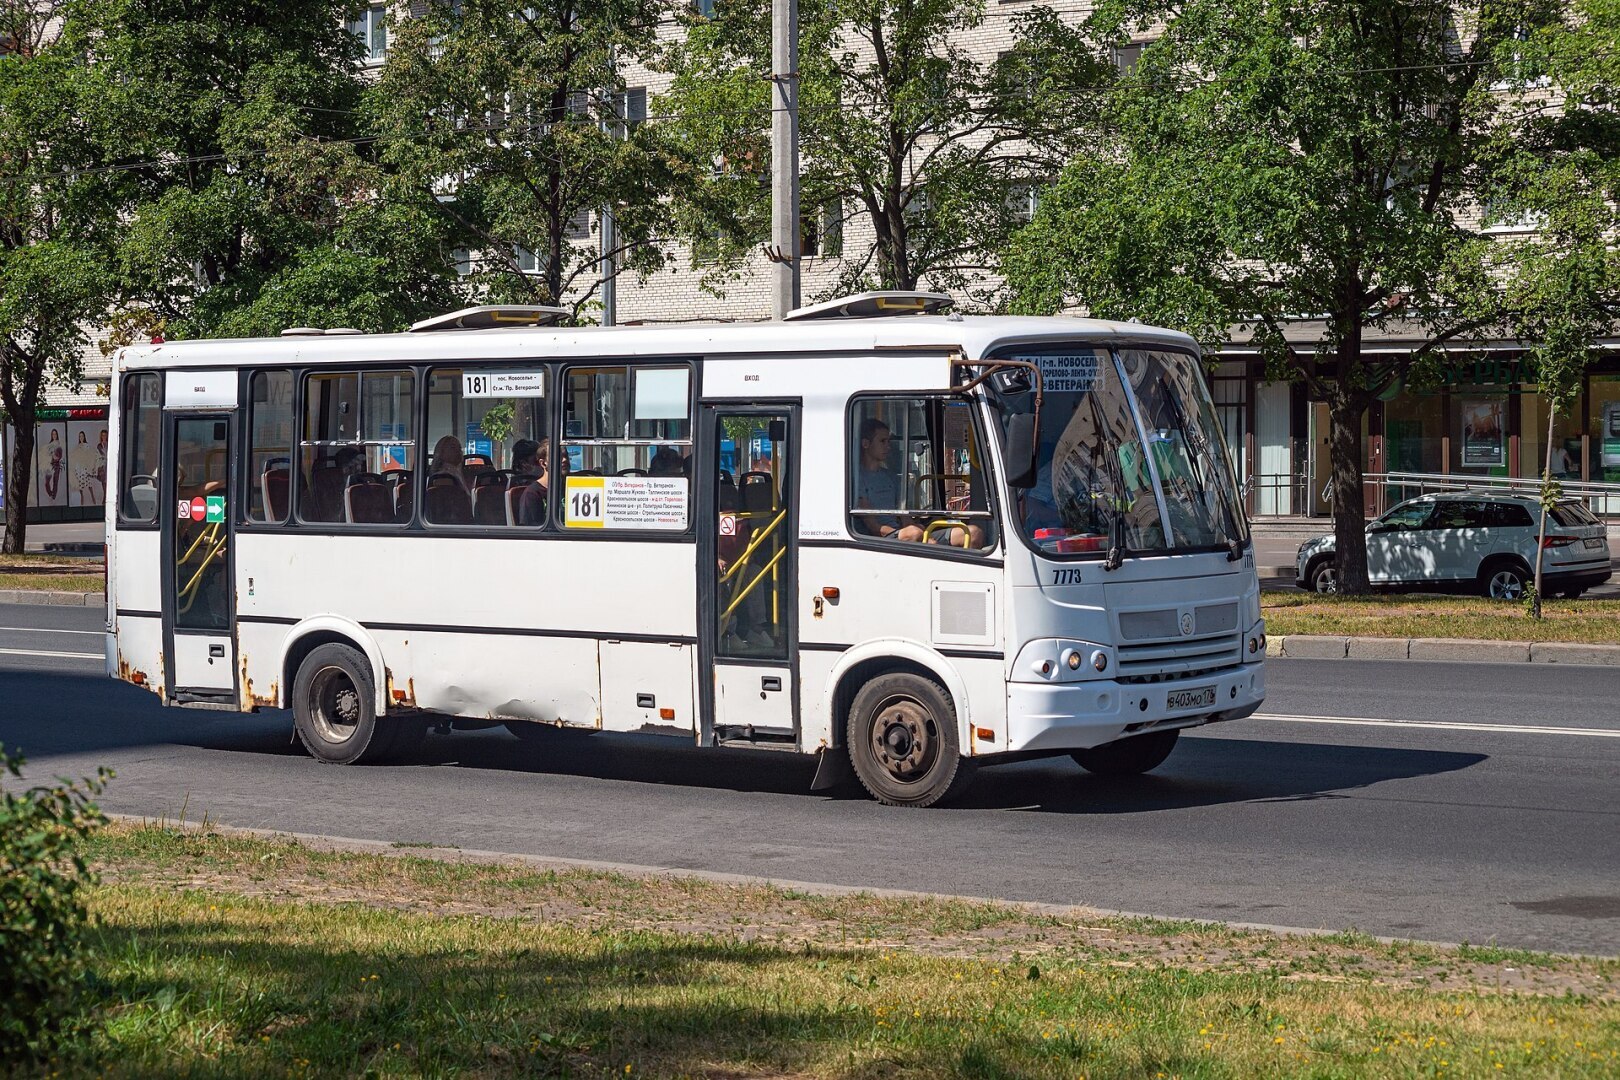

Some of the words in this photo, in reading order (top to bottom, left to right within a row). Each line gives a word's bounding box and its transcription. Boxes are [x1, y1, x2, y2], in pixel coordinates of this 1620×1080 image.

[466, 376, 487, 394] 181
[571, 492, 600, 517] 181
[1052, 568, 1082, 584] 7773
